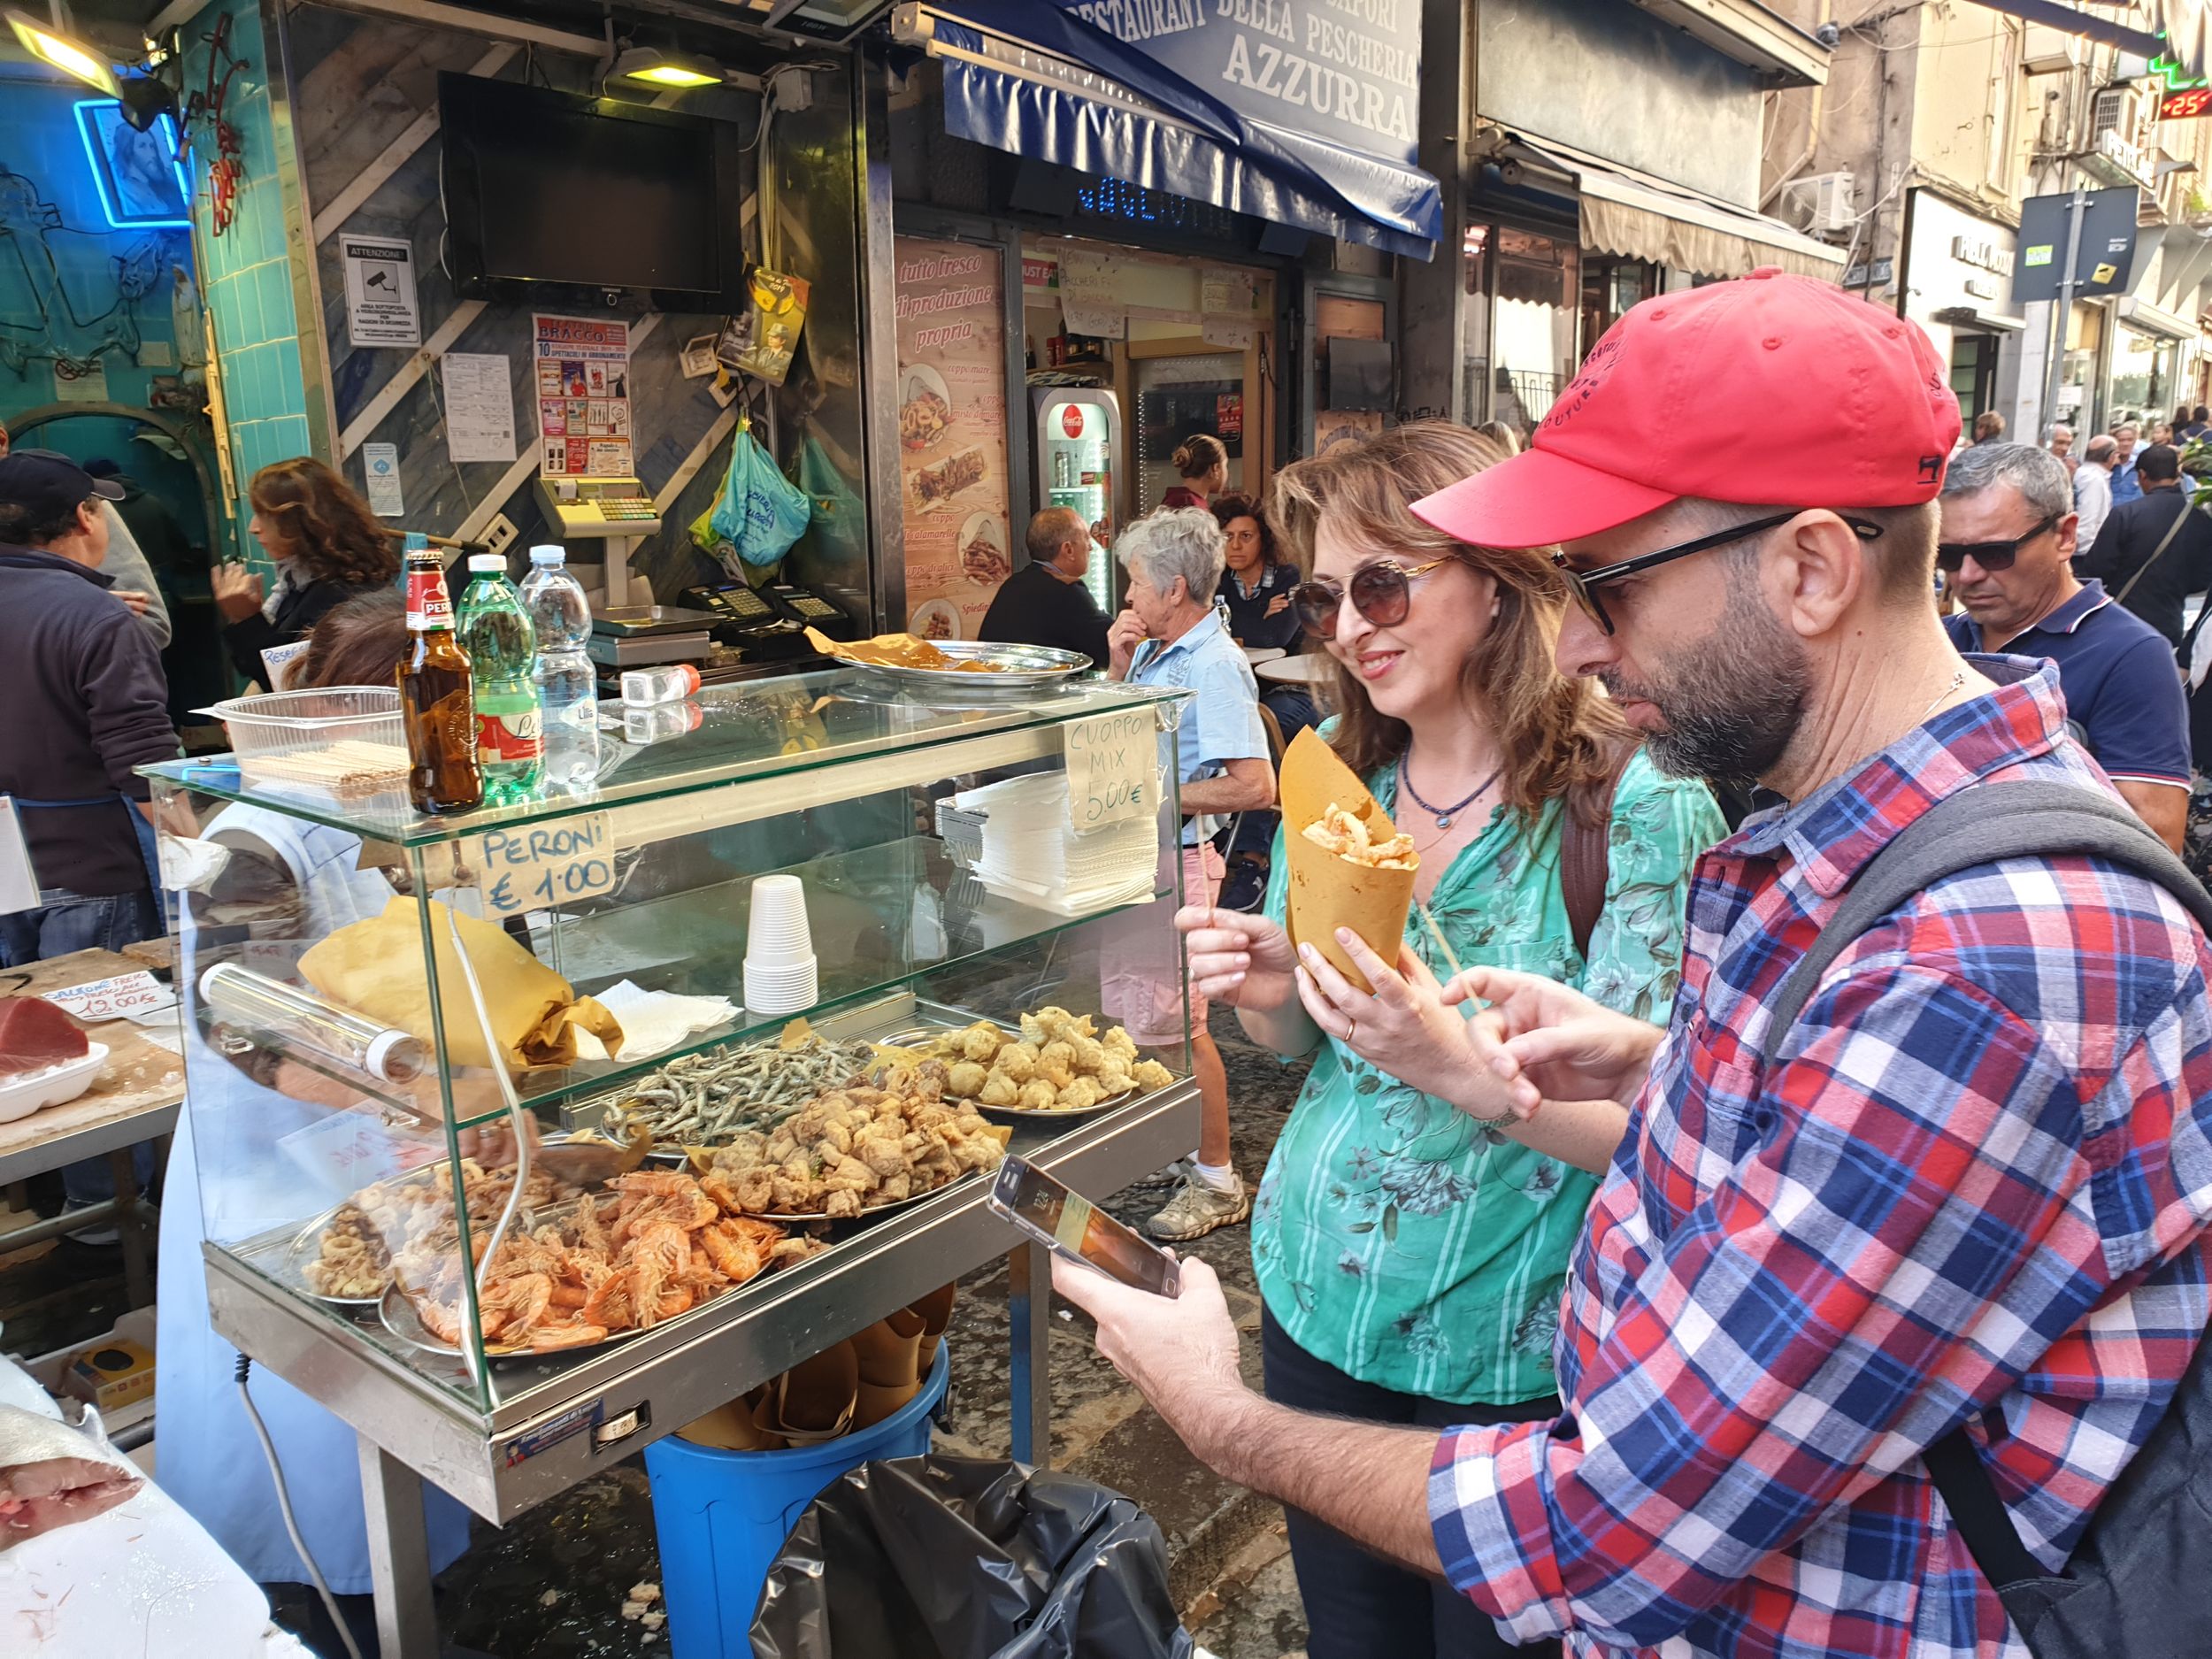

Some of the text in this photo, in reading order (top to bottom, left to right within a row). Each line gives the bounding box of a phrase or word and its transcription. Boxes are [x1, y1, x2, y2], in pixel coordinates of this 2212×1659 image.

[1064, 0, 1206, 42] ESTAURANT
[1325, 0, 1397, 34] ORI
[1305, 12, 1418, 90] PESCHERIA
[1221, 33, 1413, 143] AZZURRA
[900, 254, 981, 283] tutto fresco
[1024, 265, 1042, 278] UST
[910, 284, 993, 321] produzione
[538, 342, 550, 357] 10
[539, 326, 606, 342] BRACCO
[916, 319, 972, 353] propria
[1538, 380, 1598, 429] OUTURE
[1071, 715, 1142, 750] CUOPPO
[1090, 748, 1125, 774] MIX
